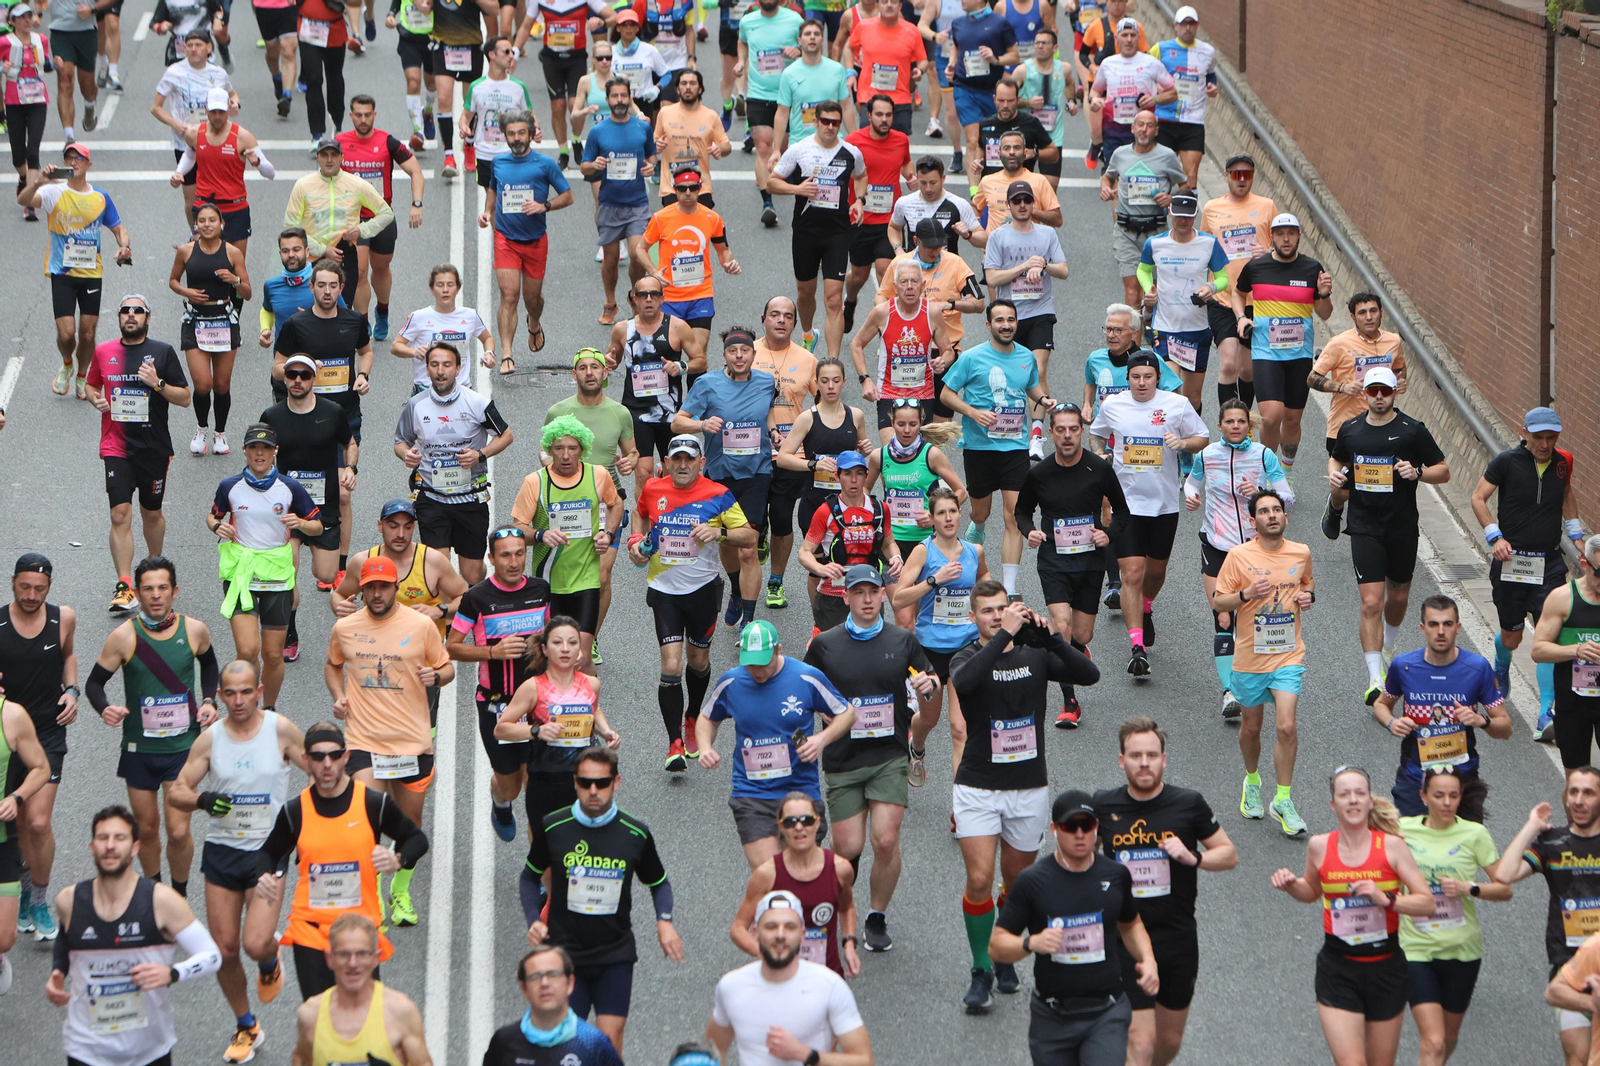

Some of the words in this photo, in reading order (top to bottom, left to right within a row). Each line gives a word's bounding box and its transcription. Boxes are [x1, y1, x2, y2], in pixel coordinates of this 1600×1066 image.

[359, 160, 385, 168] Lentos
[1233, 228, 1254, 237] ZURICH
[682, 256, 701, 265] ZURICH
[1281, 318, 1300, 326] ZURICH
[324, 359, 345, 367] ZURICH
[642, 363, 663, 372] ZURICH
[122, 388, 145, 396] ZURICH
[736, 421, 757, 429] ZURICH
[1365, 457, 1388, 465] ZURICH
[1365, 468, 1378, 476] 5272
[563, 501, 586, 510] ZURICH
[1067, 517, 1090, 526] ZURICH
[1268, 616, 1291, 624] ZURICH
[356, 651, 379, 659] Maratón
[992, 666, 1032, 682] GYMSHARK
[157, 695, 184, 704] ZURICH
[864, 697, 889, 705] ZURICH
[1409, 692, 1468, 703] BASTITANIA
[564, 706, 589, 714] ZURICH
[564, 719, 581, 728] 3702
[1006, 718, 1031, 731] ZURICH
[1432, 725, 1461, 735] ZURICH
[755, 736, 781, 746] ZURICH
[1002, 744, 1027, 754] MONSTER
[236, 796, 265, 804] ZURICH
[1113, 824, 1177, 849] parkrun
[1133, 850, 1163, 859] ZURICH
[323, 864, 354, 873] ZURICH
[588, 869, 618, 879] ZURICH
[1327, 870, 1382, 880] SERPENTINE
[1067, 915, 1097, 927] ZURICH
